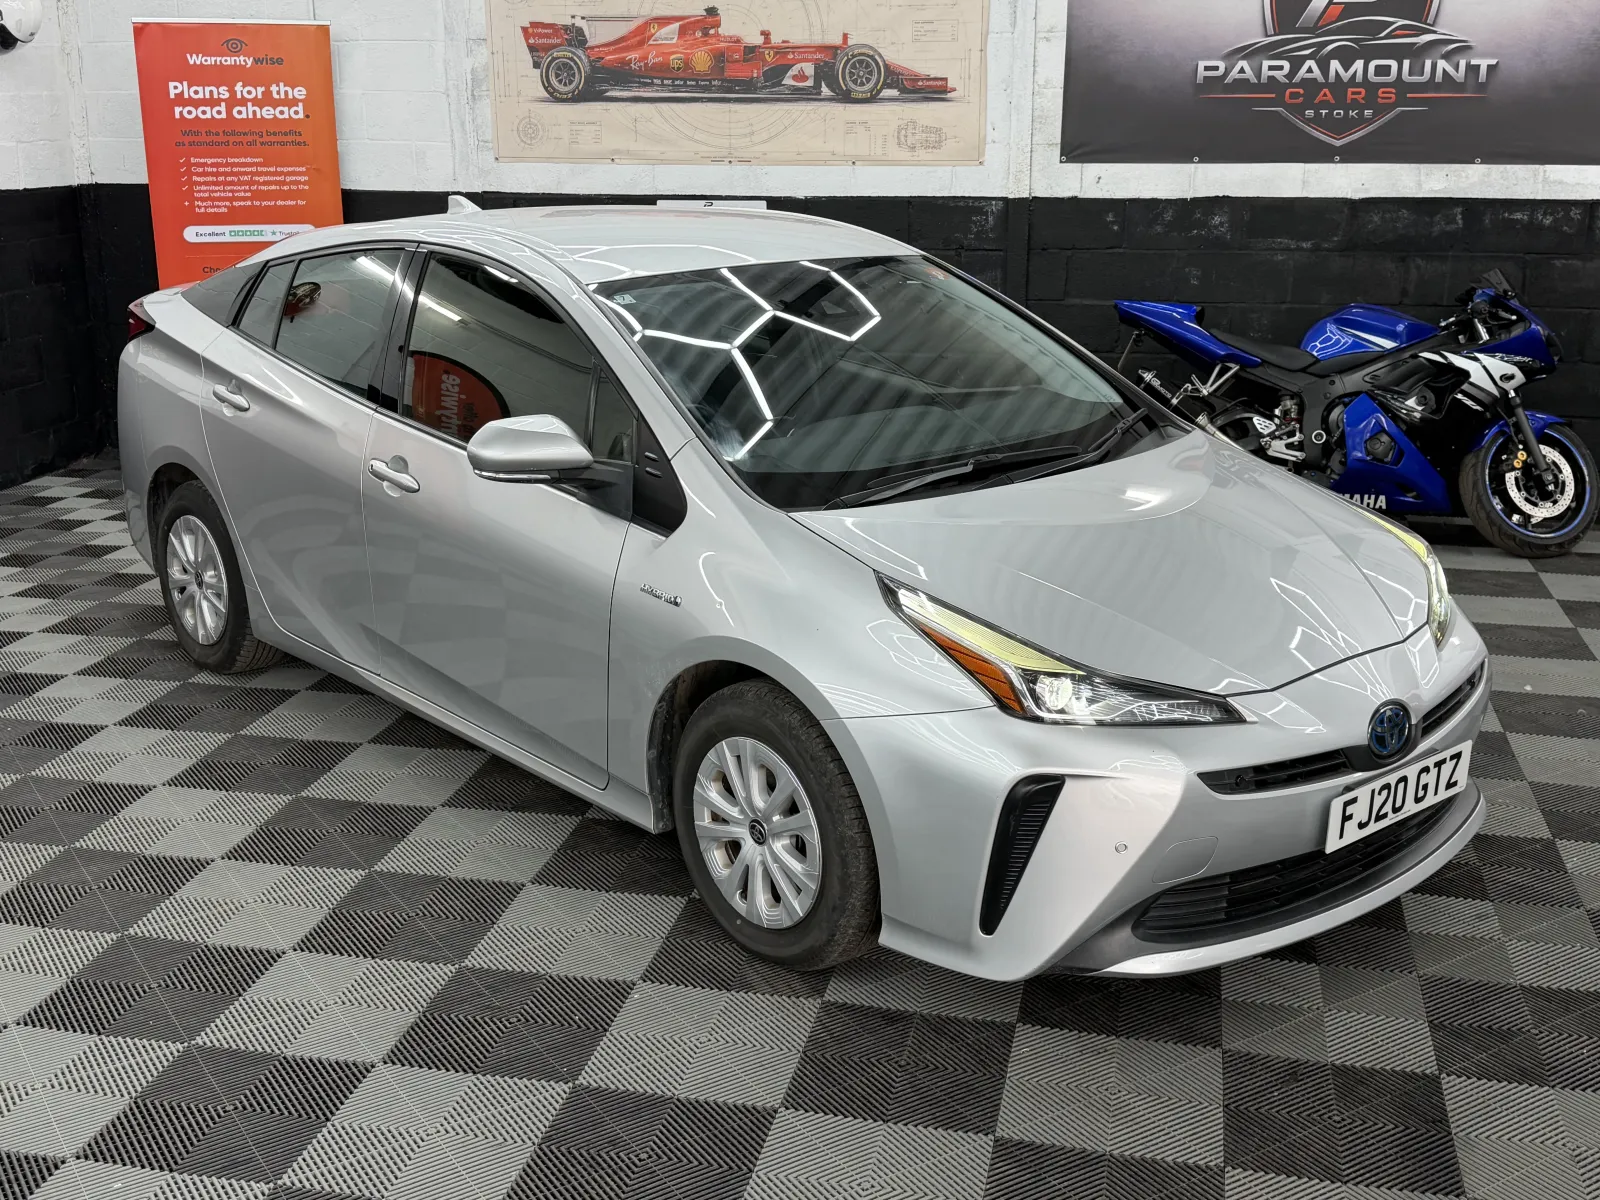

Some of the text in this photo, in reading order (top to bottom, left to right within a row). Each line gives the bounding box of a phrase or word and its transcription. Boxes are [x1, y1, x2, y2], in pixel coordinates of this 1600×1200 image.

[186, 54, 284, 68] Warrantywise
[626, 51, 663, 71] Ray-Ban
[1196, 59, 1499, 84] PARAMOUNT
[168, 81, 306, 99] Plans for the
[1284, 88, 1397, 104] CARS
[174, 102, 310, 119] road ahead.
[1304, 110, 1374, 119] STOKE
[222, 129, 264, 138] following
[1339, 750, 1462, 840] FJ20 GTZ
